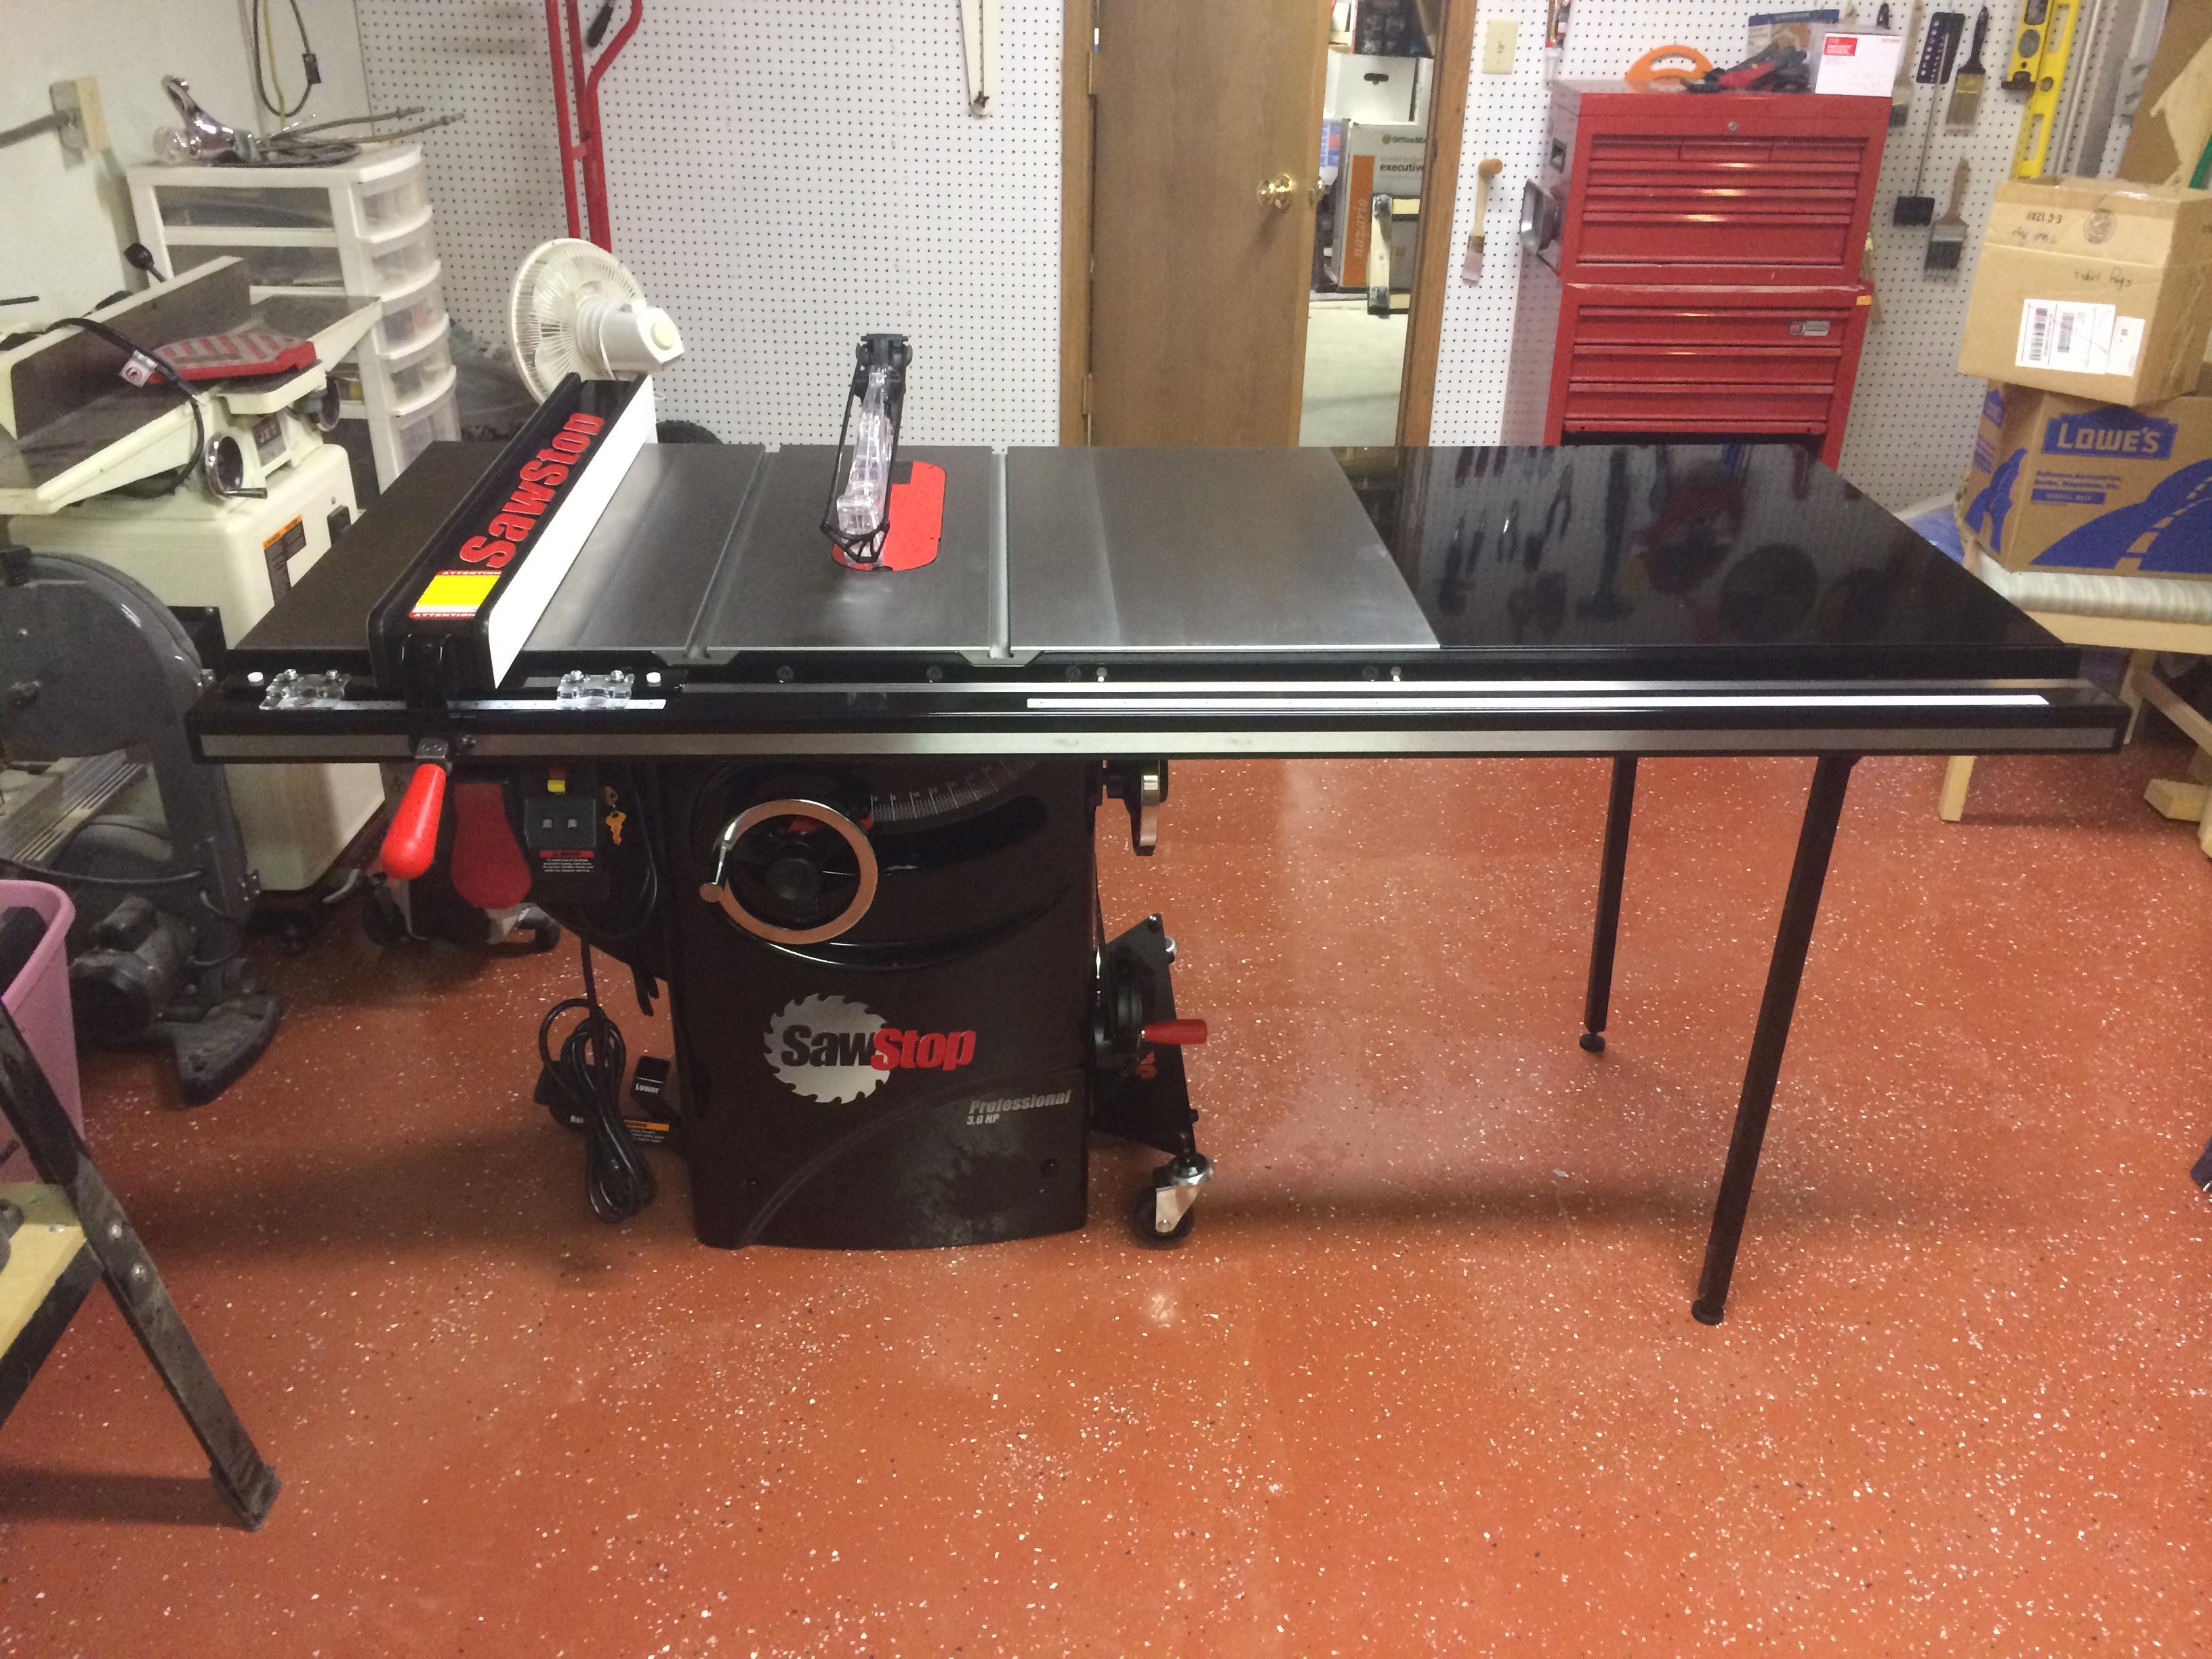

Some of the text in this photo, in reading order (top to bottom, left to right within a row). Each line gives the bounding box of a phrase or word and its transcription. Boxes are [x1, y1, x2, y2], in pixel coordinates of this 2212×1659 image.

[1380, 163, 1424, 172] executiv
[259, 423, 277, 444] JET
[459, 412, 605, 569] SawStop
[781, 1024, 977, 1071] SawStop
[635, 1083, 660, 1094] Lower
[968, 1089, 1072, 1115] Professional
[966, 1113, 1000, 1126] 3.0 HP
